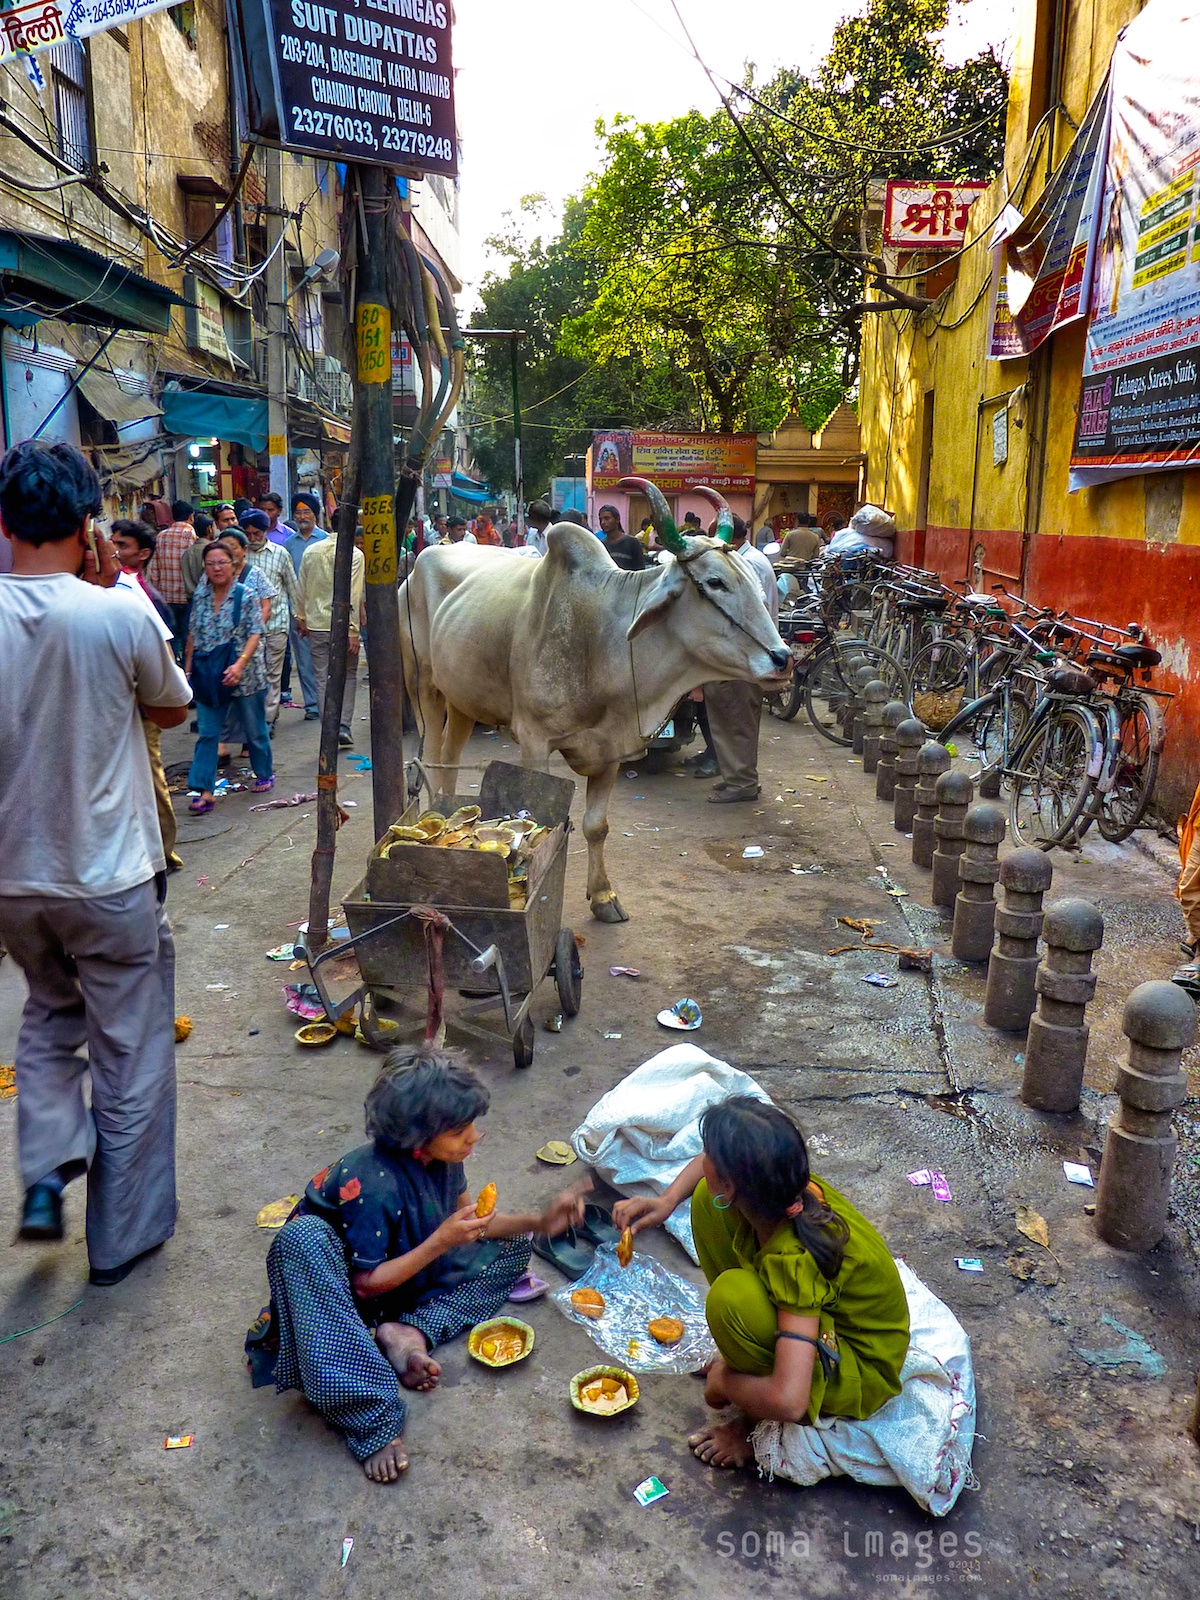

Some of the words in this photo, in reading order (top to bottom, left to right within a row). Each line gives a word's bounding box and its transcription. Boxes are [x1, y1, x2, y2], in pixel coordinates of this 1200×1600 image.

[1, 6, 63, 52] दिल्ली
[291, 0, 337, 37] SUIT
[344, 13, 437, 64] DUPATTAS
[281, 34, 330, 74] 203-204,
[330, 47, 386, 87] BASEMENT,
[387, 62, 418, 92] KATRA
[419, 70, 450, 100] NAWAB
[311, 76, 357, 110] CHANDNI
[358, 87, 396, 122] CHOWK,
[397, 97, 432, 127] DELHI-6
[292, 106, 378, 151] 23276033,
[382, 125, 452, 161] 23279248
[1114, 373, 1146, 400] Lehangas,
[1147, 367, 1173, 390] Sarees,
[1174, 359, 1197, 385] Suits,
[687, 435, 720, 445] महादेव
[1080, 410, 1109, 436] SHREE
[636, 446, 650, 454] शिव
[675, 446, 689, 454] सेवा
